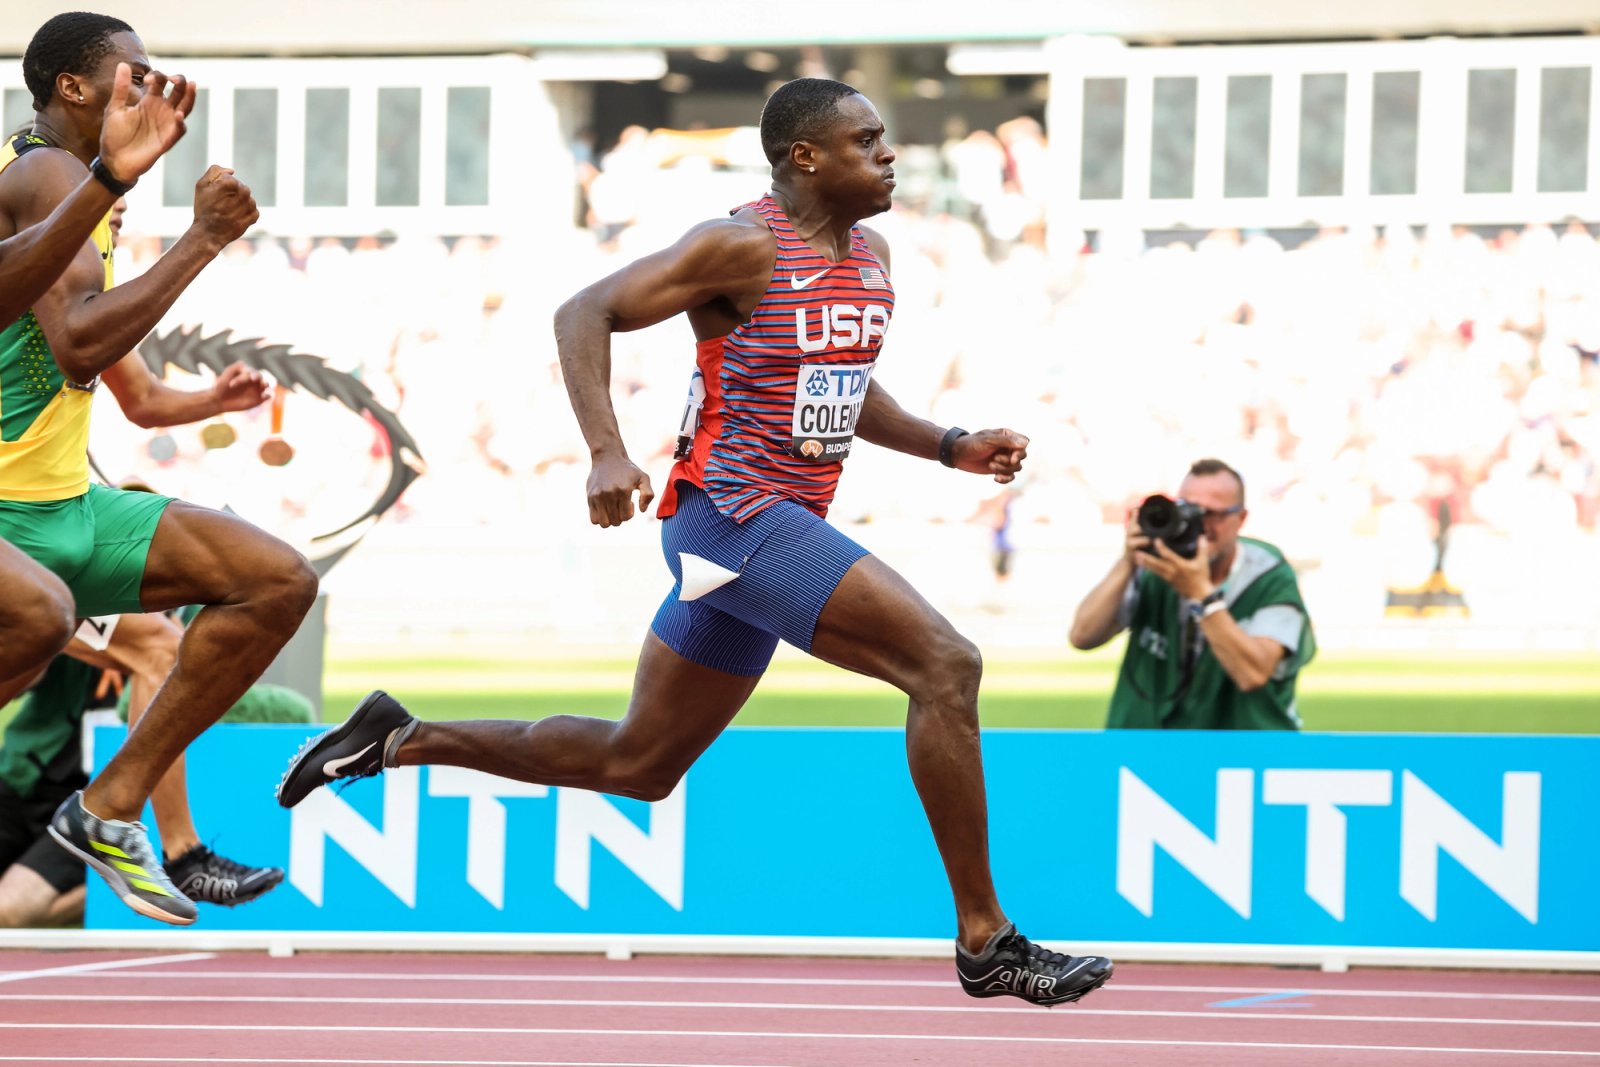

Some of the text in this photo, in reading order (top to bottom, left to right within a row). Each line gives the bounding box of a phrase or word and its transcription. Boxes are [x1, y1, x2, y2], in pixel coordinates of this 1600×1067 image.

[796, 304, 889, 352] USA
[830, 367, 872, 396] TDK
[800, 401, 863, 433] COLEM
[825, 441, 852, 454] BUDAPE
[288, 764, 687, 912] NTN
[1116, 765, 1542, 925] NTN
